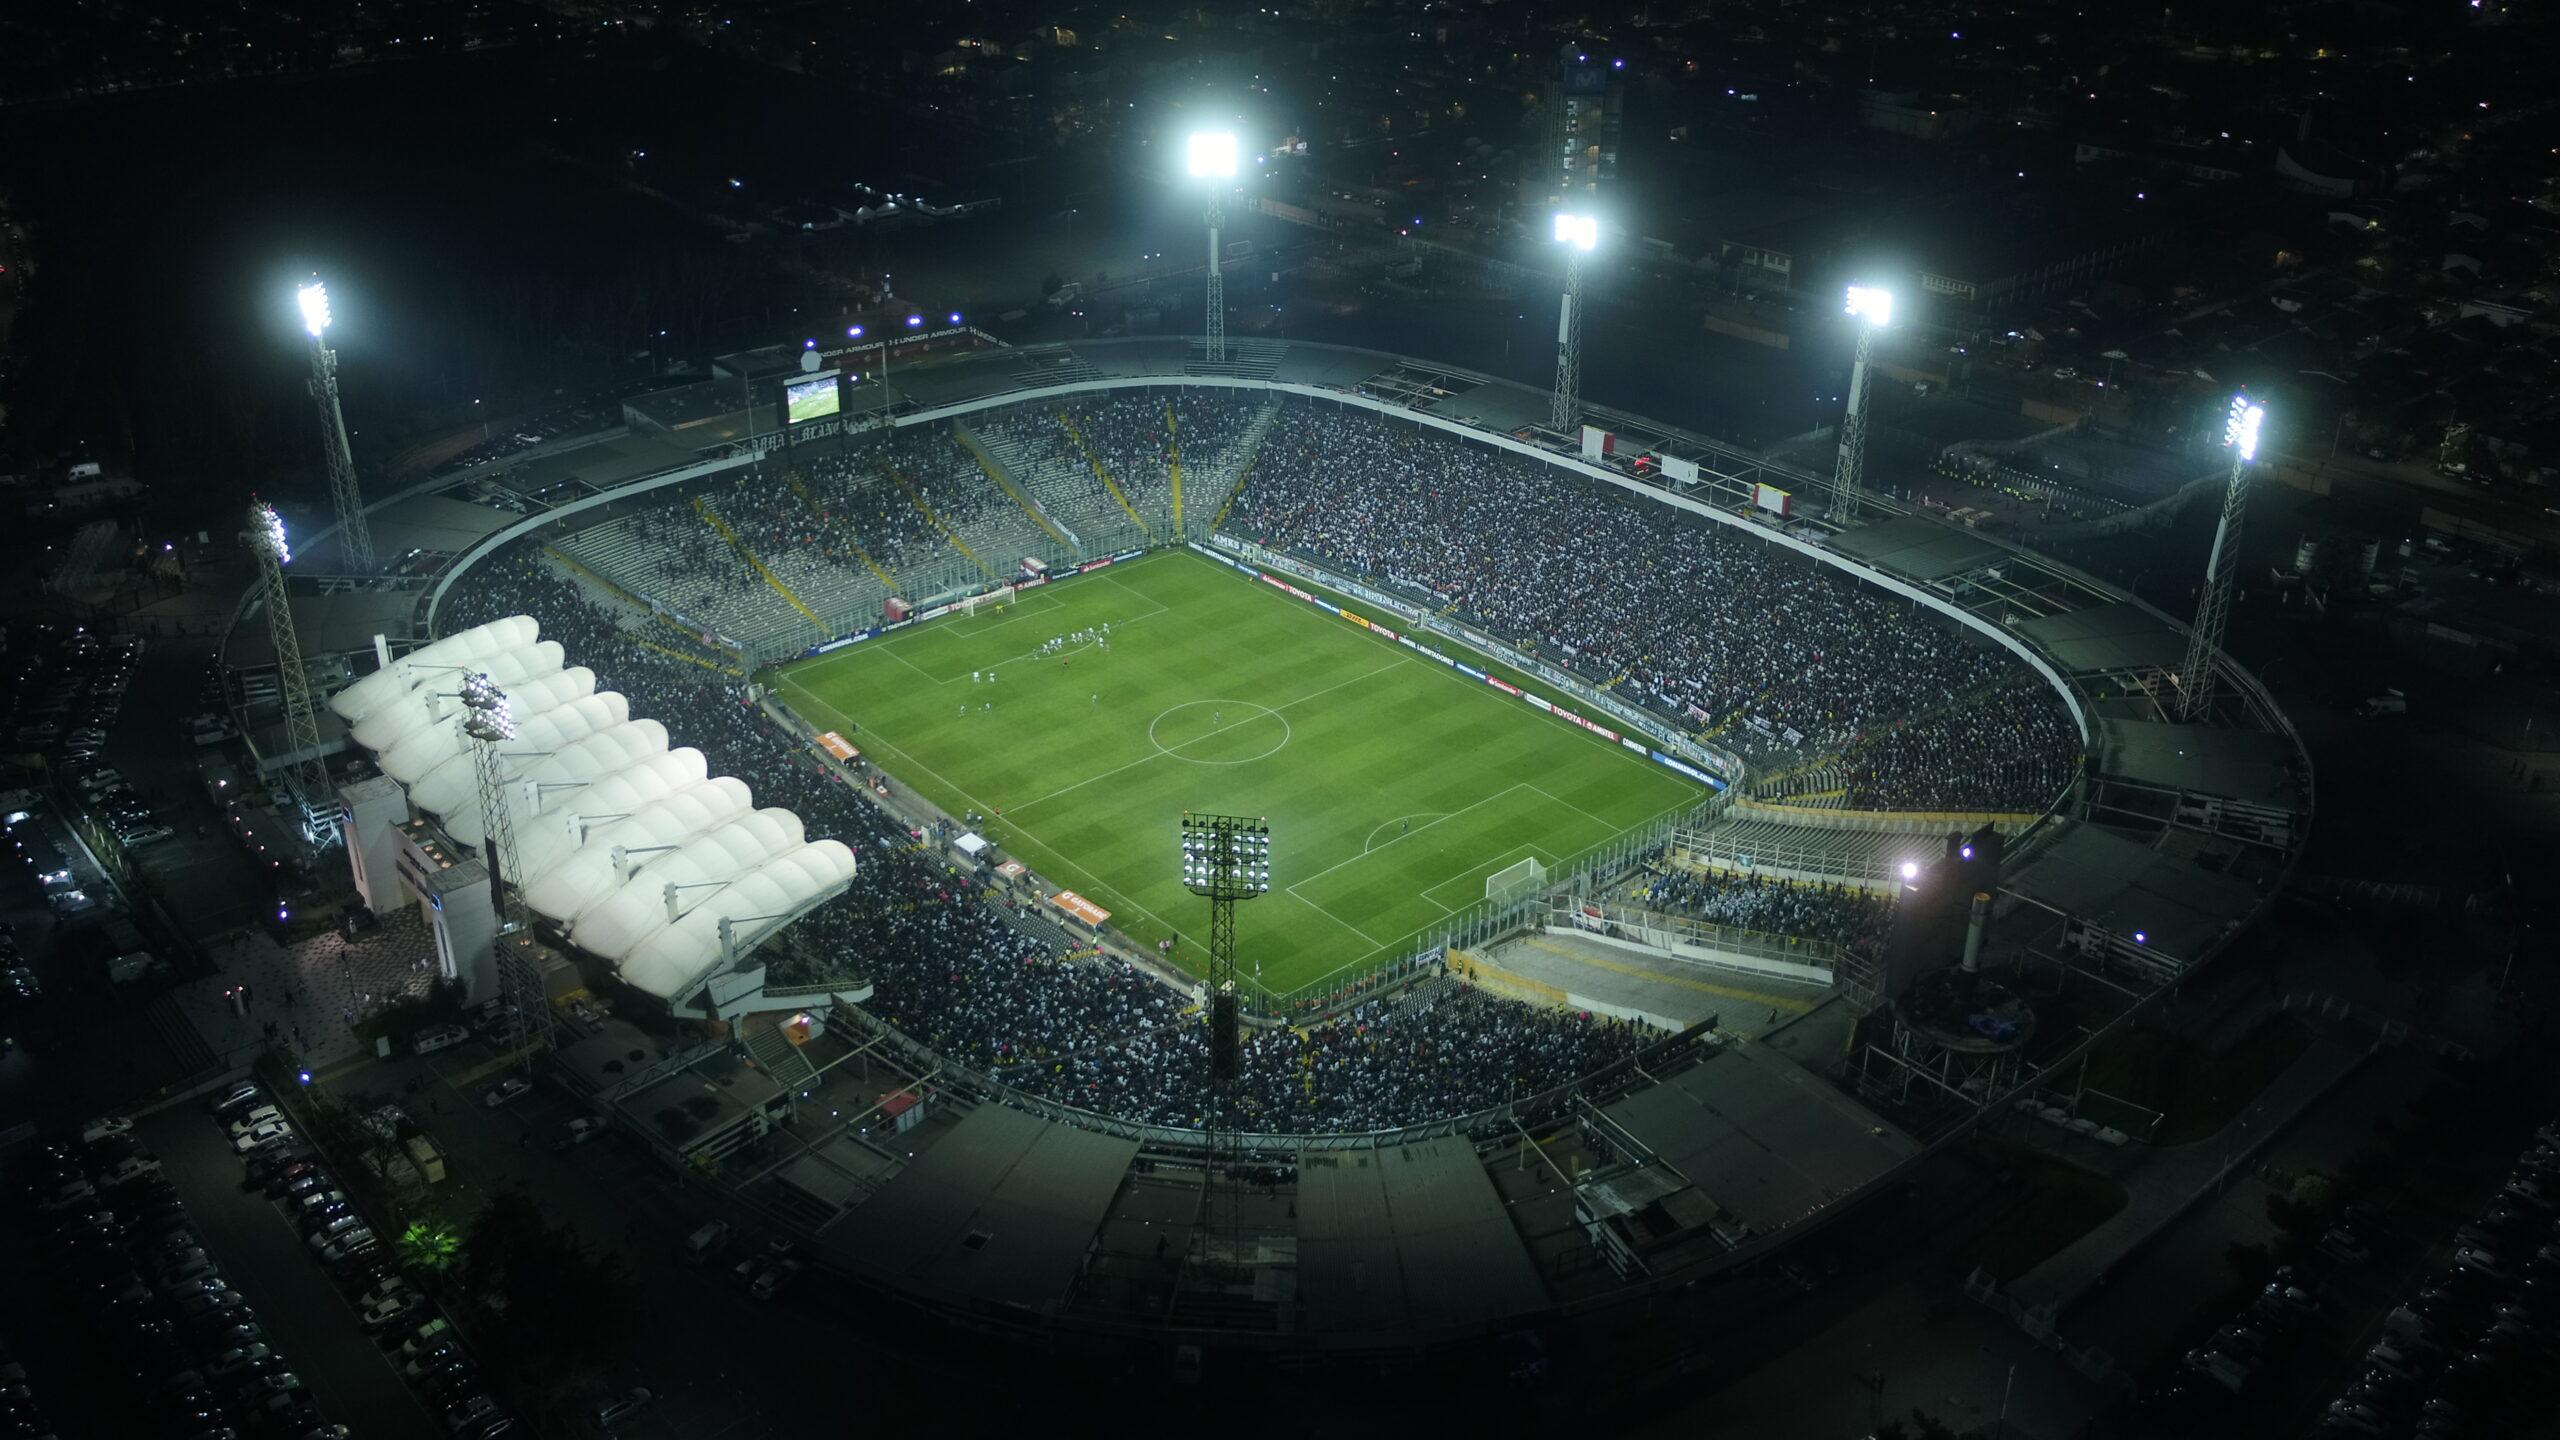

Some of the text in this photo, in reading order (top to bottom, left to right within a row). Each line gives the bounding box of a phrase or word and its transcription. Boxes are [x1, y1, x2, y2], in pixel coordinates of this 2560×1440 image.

[899, 326, 967, 344] UNDER ARMOUR
[820, 341, 885, 359] NDER ARMOUR
[1023, 577, 1046, 590] AMSTEL
[1288, 584, 1313, 603] TOYOTA
[1370, 622, 1395, 640] TOYOTA
[1417, 644, 1455, 667] LIBERTADORES
[1553, 705, 1582, 726] TOYOTA
[1592, 723, 1615, 740] AMSTEL
[1007, 863, 1020, 872] G
